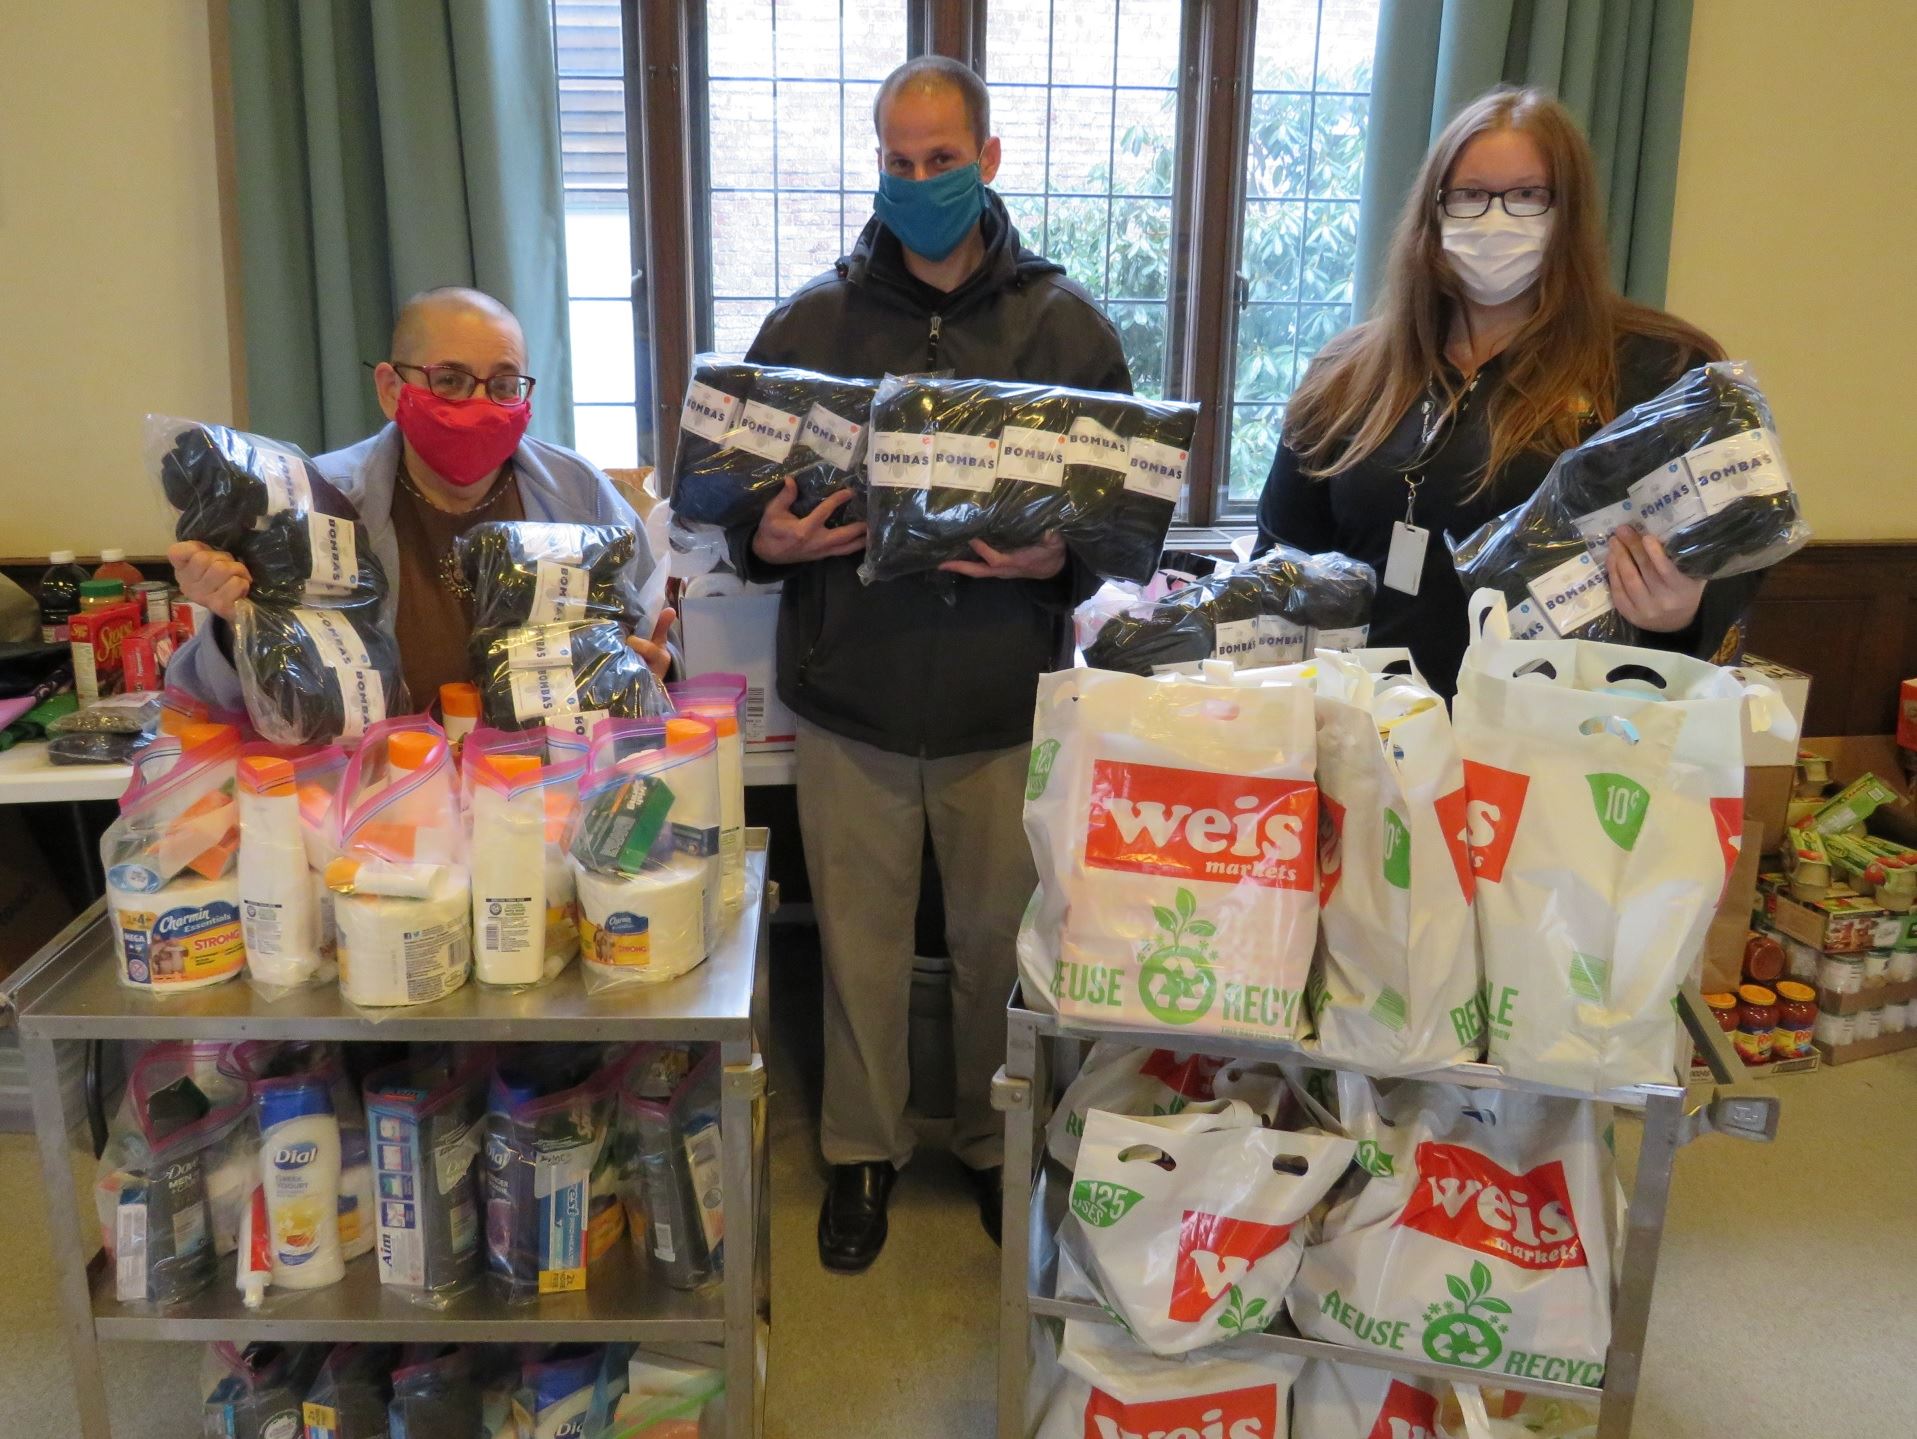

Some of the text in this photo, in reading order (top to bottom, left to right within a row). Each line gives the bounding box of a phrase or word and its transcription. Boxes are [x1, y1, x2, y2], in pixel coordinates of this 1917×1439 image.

[687, 399, 726, 422] BOMBAS
[741, 418, 791, 442] BOMBAS
[1004, 446, 1063, 464] BOMBAS
[1069, 434, 1126, 453] BOMBAS
[874, 453, 929, 465] BOMBAS
[936, 453, 994, 469] BOMBAS
[1130, 457, 1182, 480] BOMBAS
[1698, 454, 1772, 486] BOMBAS
[1641, 484, 1689, 518] BOMBAS
[328, 518, 340, 581] BOMBAS
[1219, 640, 1256, 655] BOMBAS
[1258, 635, 1303, 646] BOMBAS
[538, 670, 552, 709] BOMBAS
[1604, 785, 1640, 825] 10¢
[1104, 795, 1303, 861] weis
[1205, 859, 1297, 882] markets
[160, 908, 210, 933] Charmin
[184, 913, 231, 933] Essentials
[194, 929, 240, 951] STRONG
[275, 1147, 317, 1164] Dial
[1073, 1199, 1104, 1226] USES
[1089, 1182, 1129, 1220] 125
[1427, 1176, 1577, 1246] weis
[382, 1233, 392, 1267] Aim
[1496, 1236, 1578, 1264] markets
[1503, 1351, 1605, 1388] RECYC
